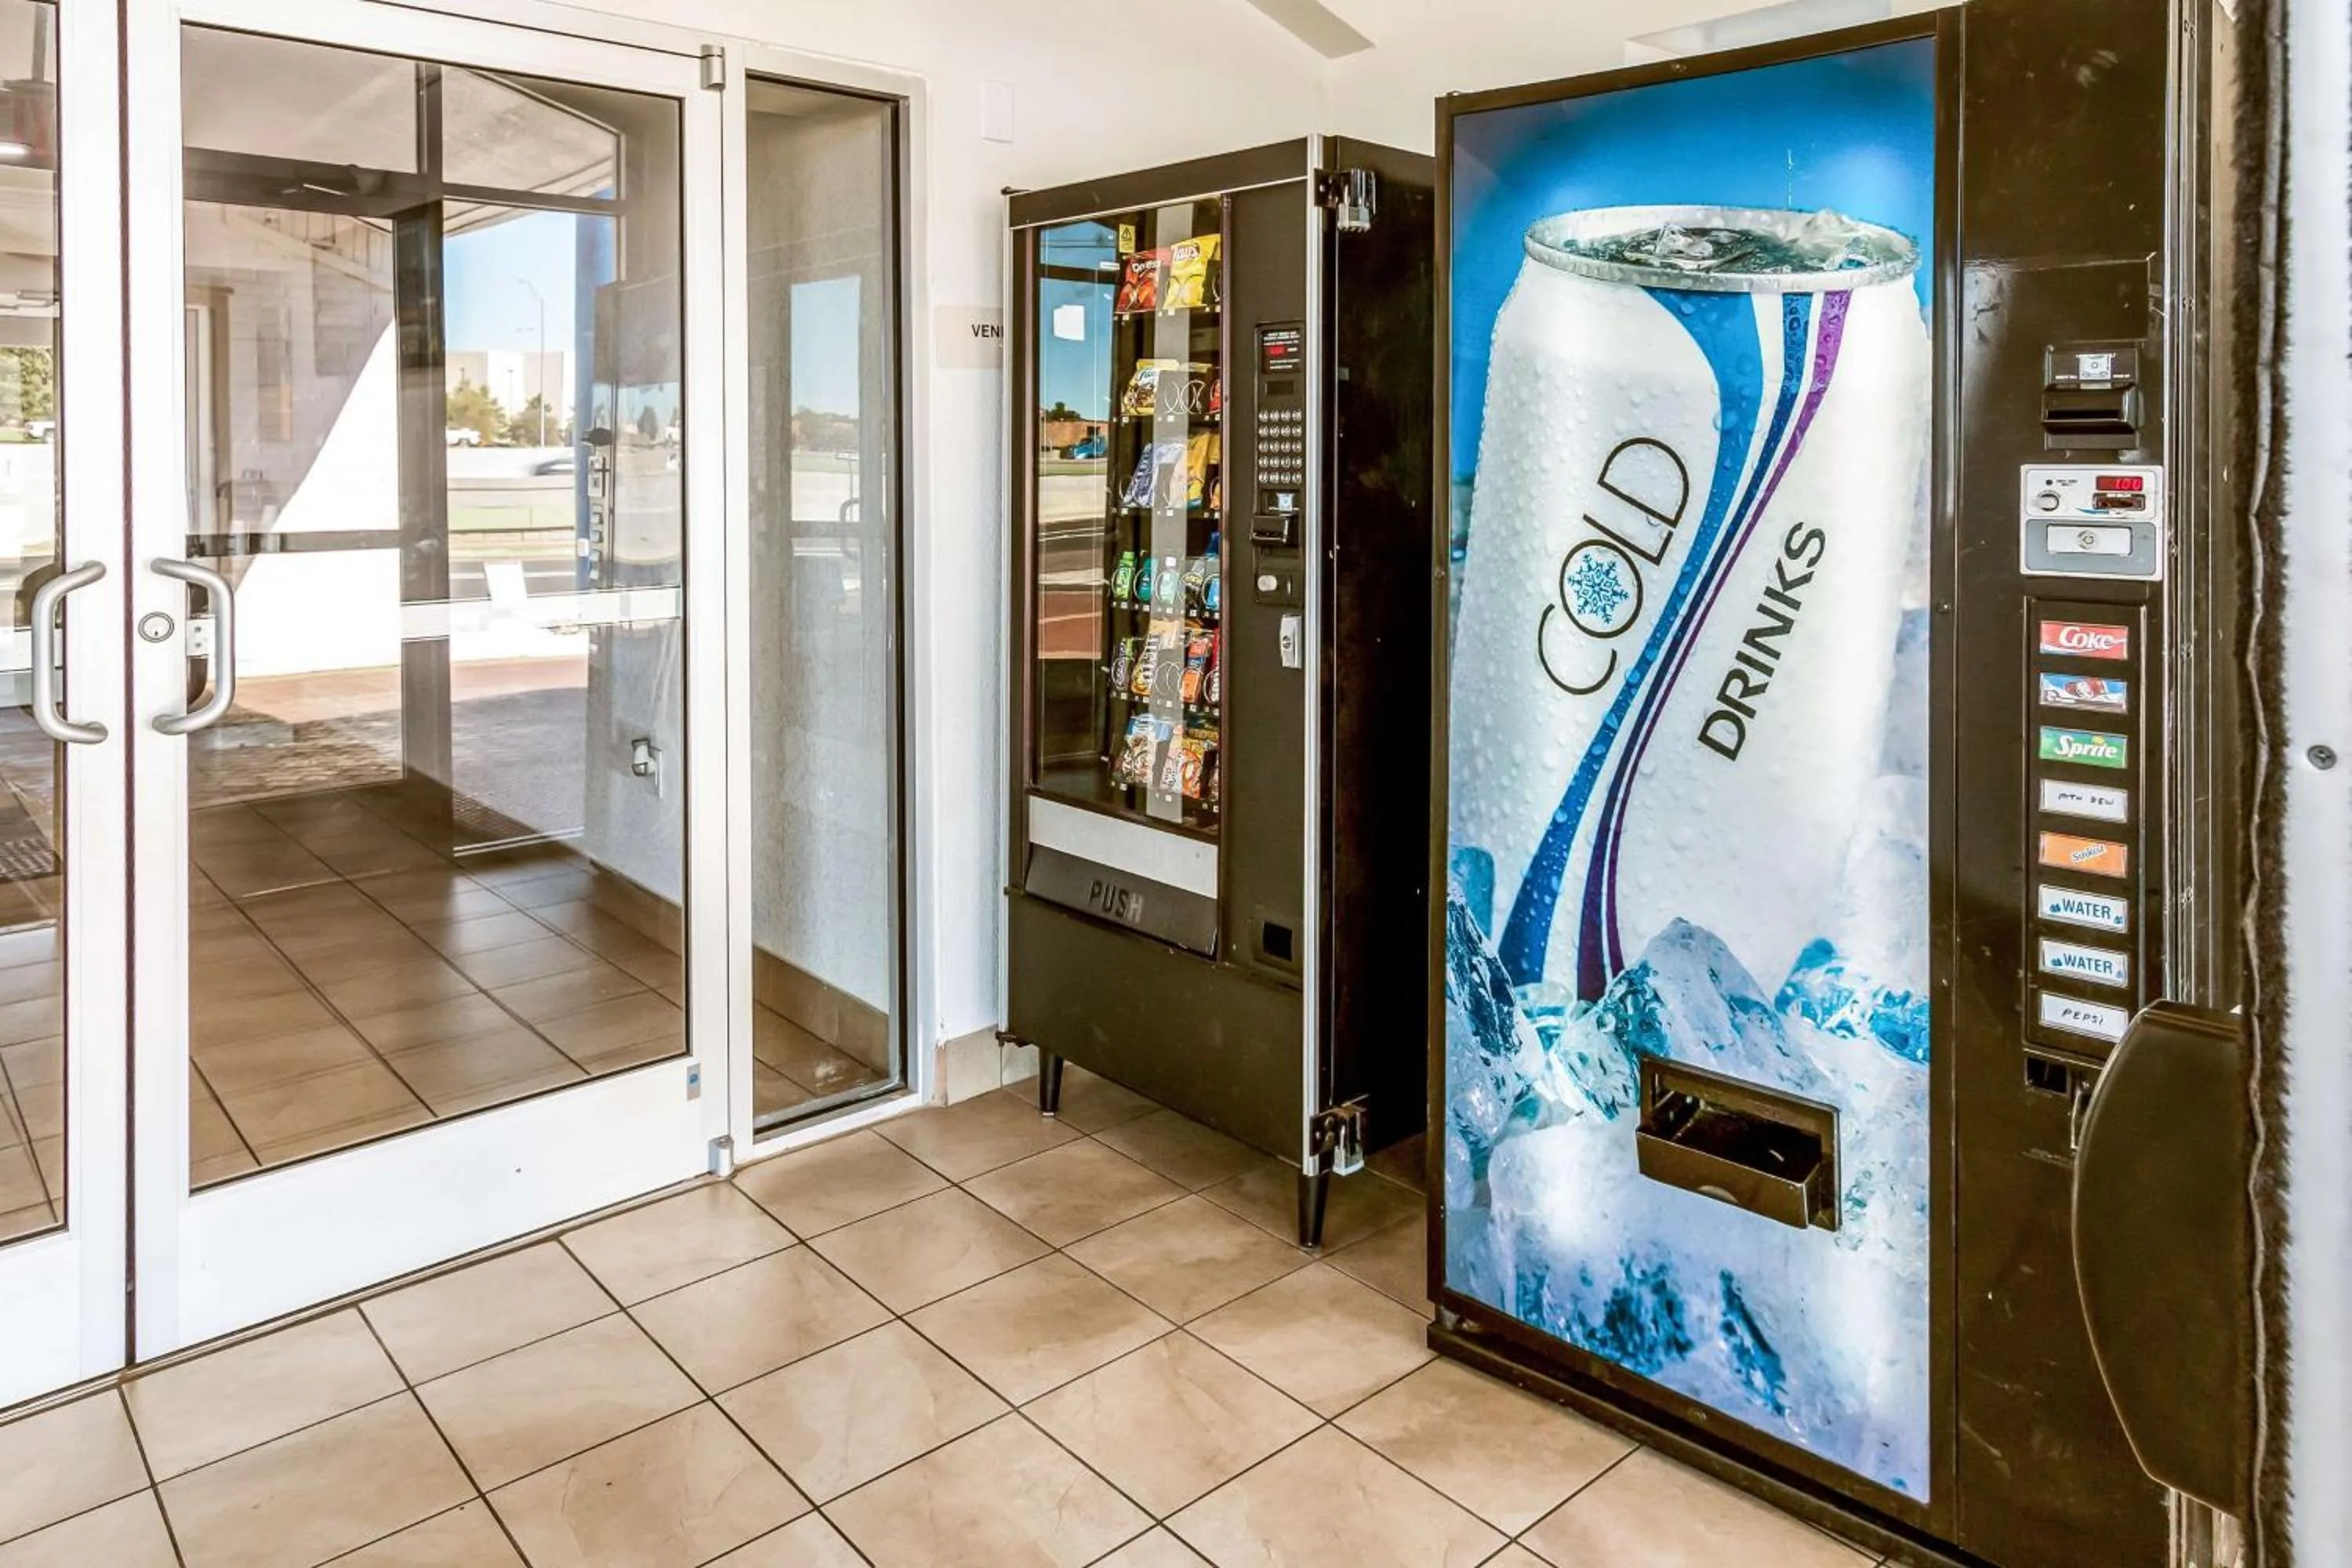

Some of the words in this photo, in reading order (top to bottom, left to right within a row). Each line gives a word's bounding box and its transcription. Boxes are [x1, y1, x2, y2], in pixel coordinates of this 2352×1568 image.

[1538, 437, 1690, 695] COLD
[1697, 521, 1826, 762] DRINKS
[2058, 626, 2117, 651] Coke
[2054, 735, 2118, 759] Sprite
[1090, 880, 1145, 924] PUSH
[2062, 898, 2112, 920] WATER
[2063, 953, 2114, 975] WATER
